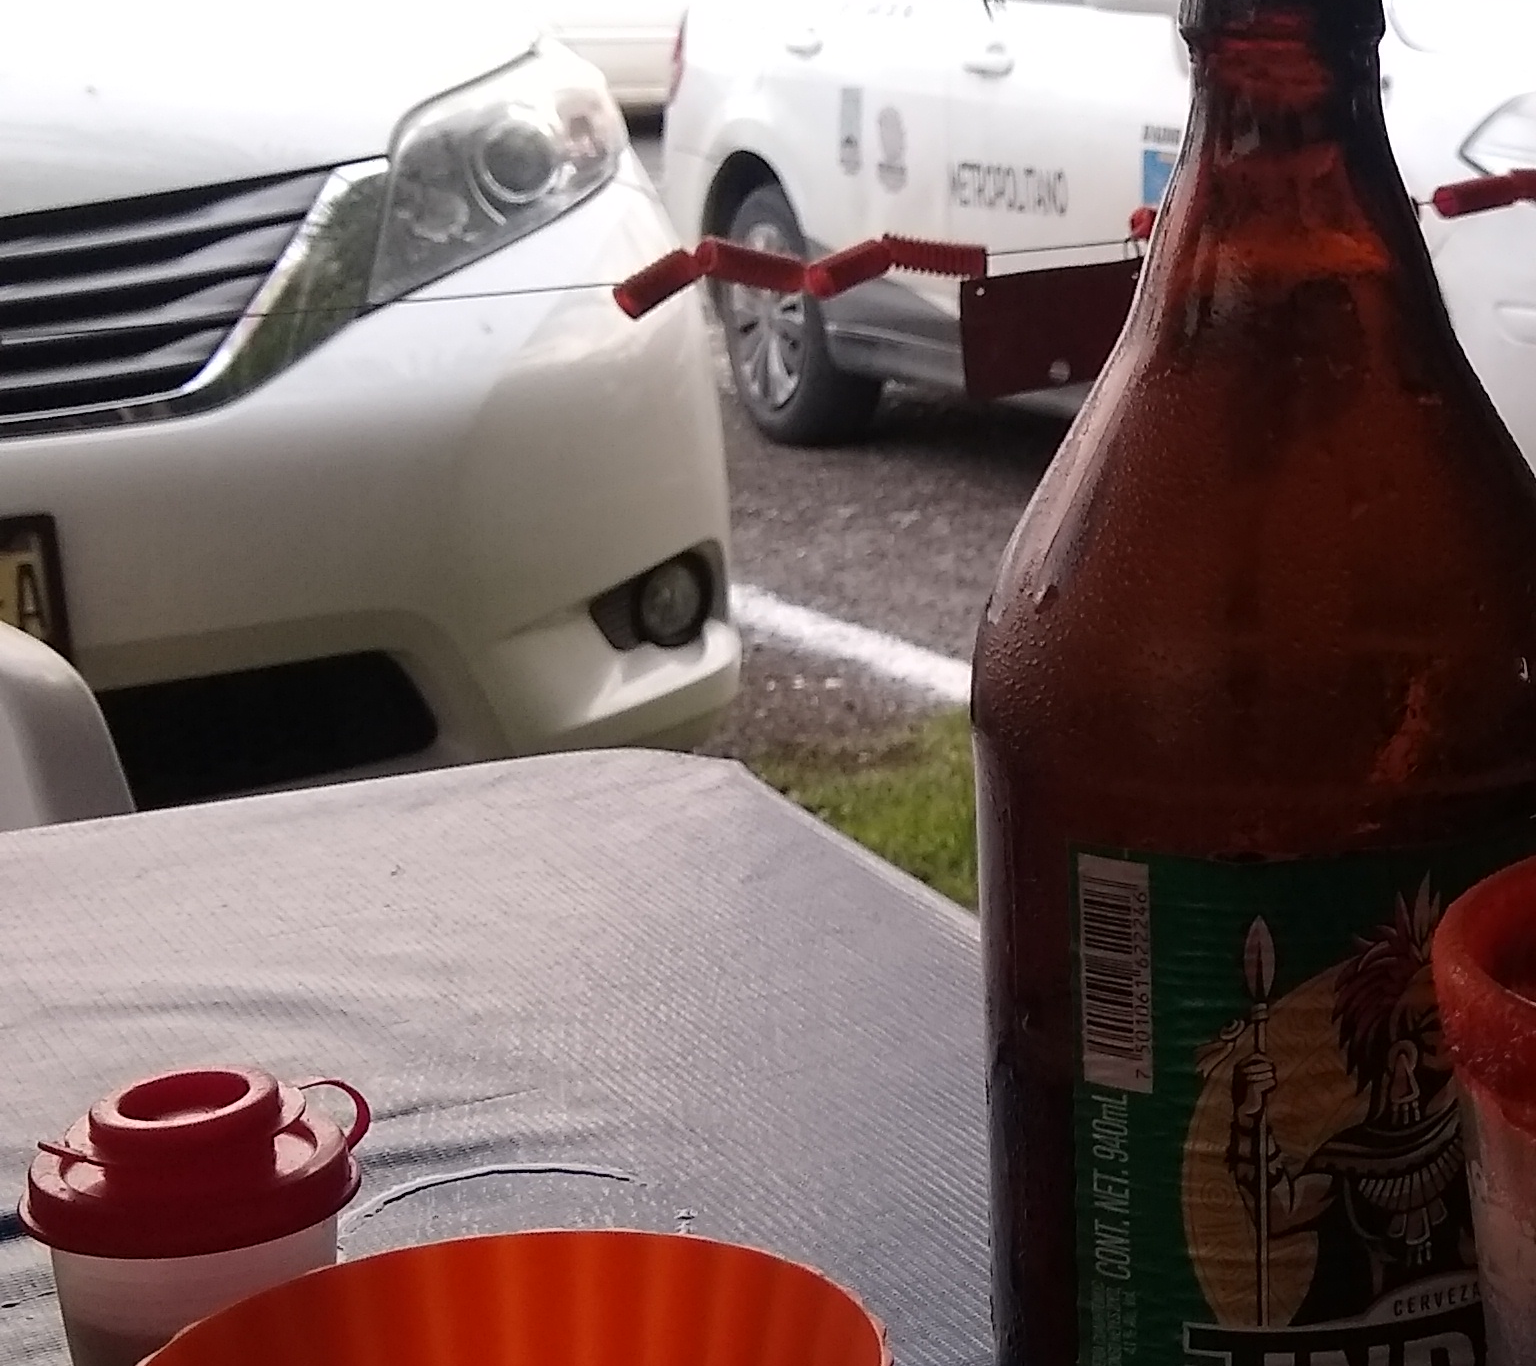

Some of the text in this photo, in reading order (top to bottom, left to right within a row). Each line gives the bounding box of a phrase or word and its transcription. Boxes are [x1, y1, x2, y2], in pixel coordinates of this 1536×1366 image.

[1090, 1093, 1130, 1163] 940mL
[1091, 1168, 1131, 1214] NET.
[1093, 1220, 1133, 1281] CONT.
[1393, 1280, 1481, 1317] CERVEZA
